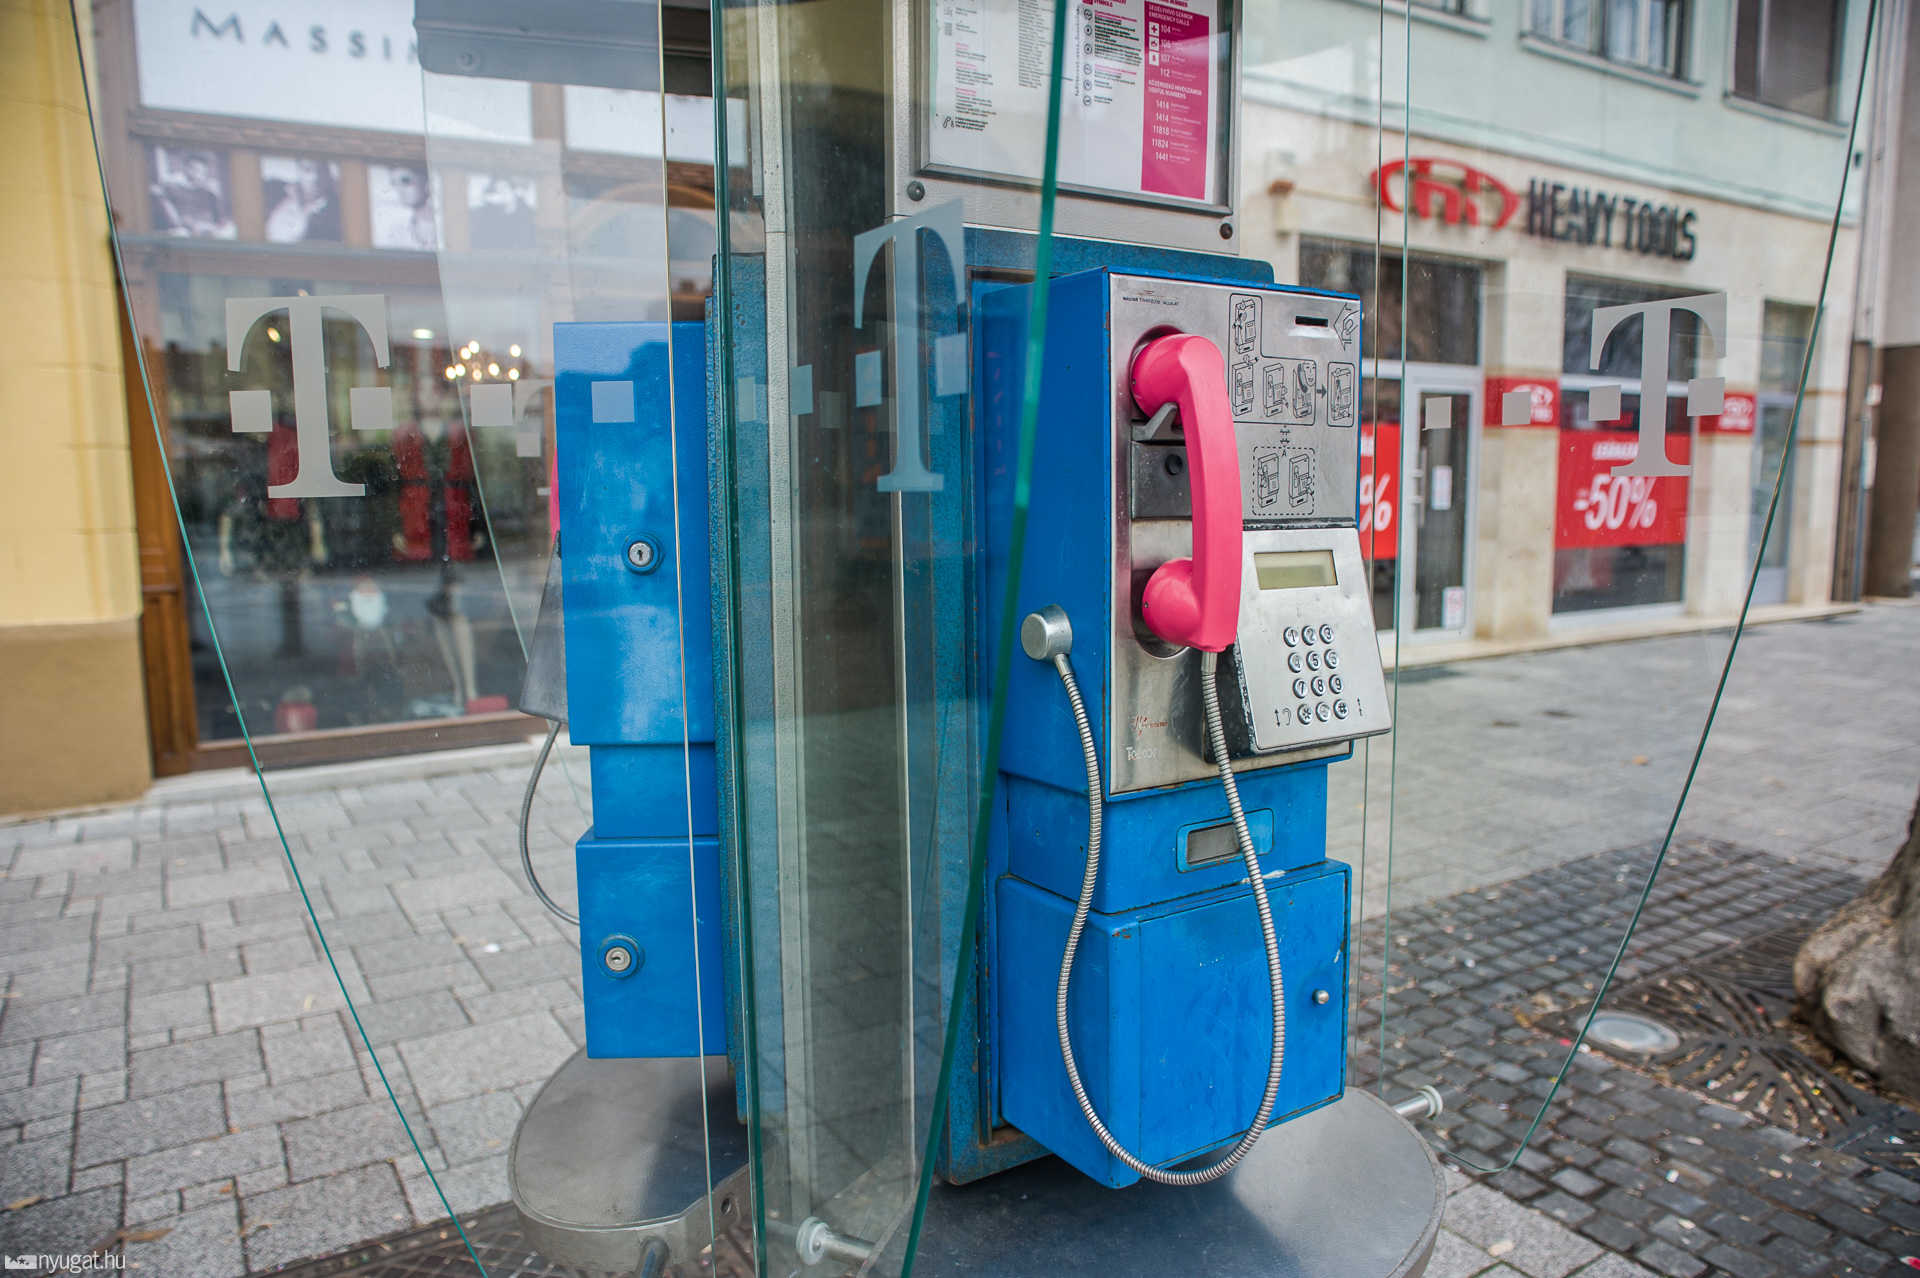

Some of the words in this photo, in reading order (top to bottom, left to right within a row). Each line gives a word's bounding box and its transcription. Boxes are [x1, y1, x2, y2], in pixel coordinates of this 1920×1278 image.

[1160, 67, 1170, 78] 112
[1151, 137, 1169, 149] 11824
[1155, 111, 1169, 123] 1414
[1527, 177, 1618, 249] HEAVY
[1623, 194, 1697, 262] TOOLS
[226, 294, 390, 498] T
[1589, 292, 1726, 477] T
[1572, 472, 1658, 530] -50%
